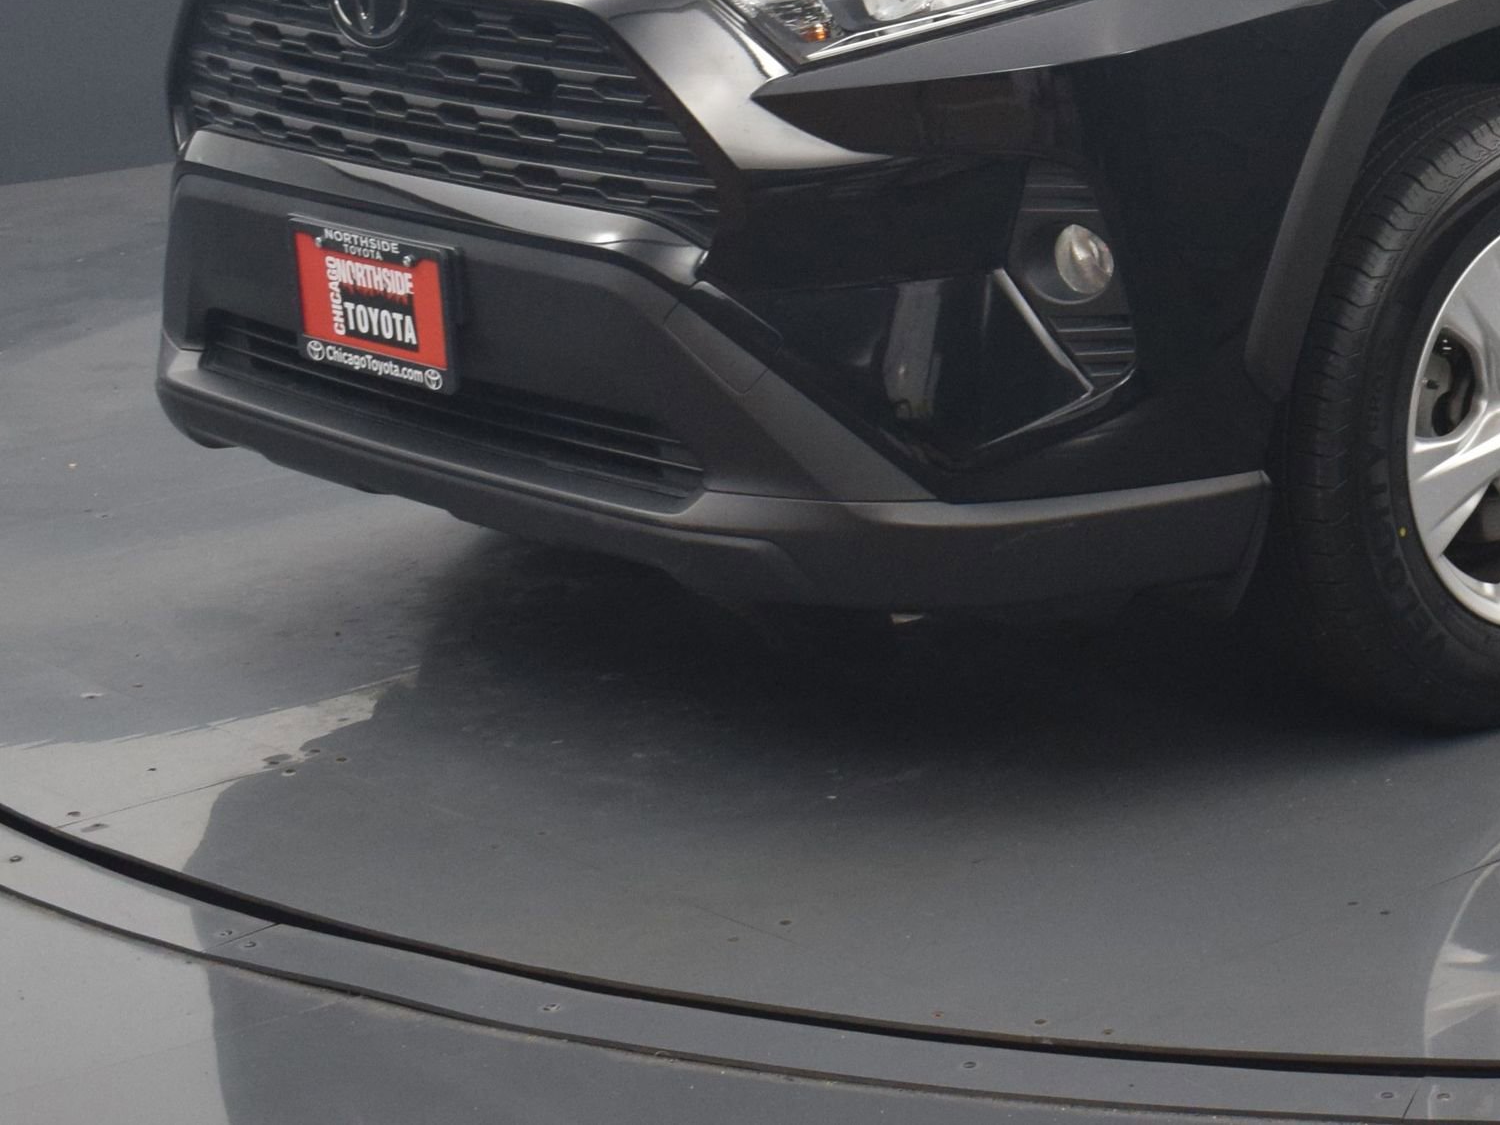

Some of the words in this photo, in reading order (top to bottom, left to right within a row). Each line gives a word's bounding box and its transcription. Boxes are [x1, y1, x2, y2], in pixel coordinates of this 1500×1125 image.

[324, 228, 400, 254] NORTHSIDE
[342, 244, 383, 261] TOYOTA
[325, 255, 347, 335] CHICAGO
[335, 259, 413, 295] NORTHSIDE
[343, 301, 417, 345] TOYOTA
[325, 345, 424, 383] ChicagoToyota.com
